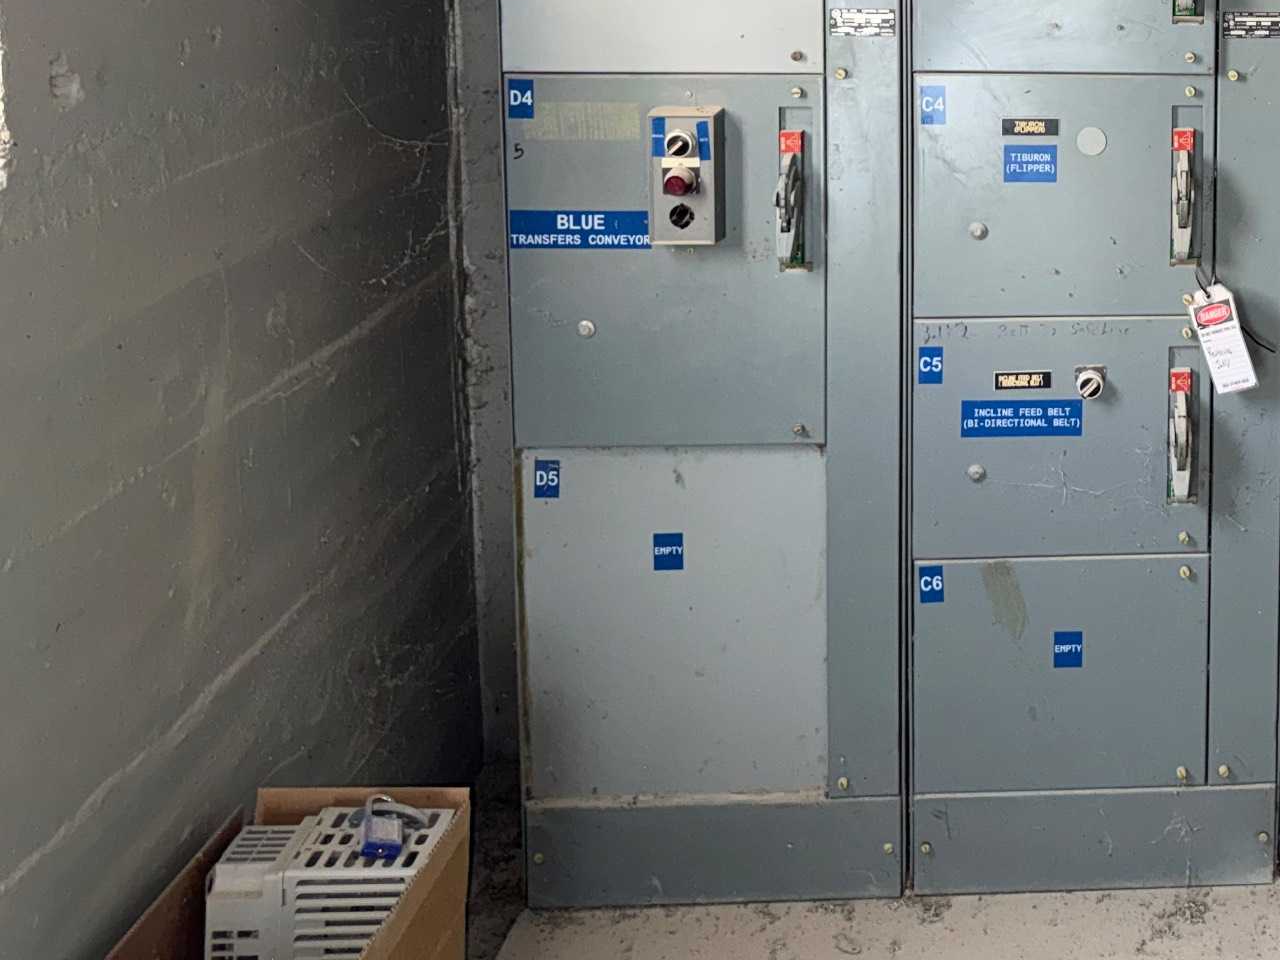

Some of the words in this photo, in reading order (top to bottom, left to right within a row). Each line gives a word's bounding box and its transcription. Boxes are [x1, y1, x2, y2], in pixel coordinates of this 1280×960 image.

[510, 90, 533, 105] D4
[922, 97, 944, 111] C4
[1010, 153, 1051, 161] TIBURON
[1006, 163, 1055, 173] (FLIPPER)
[557, 215, 605, 229] BLUE
[511, 234, 581, 245] TRANSFERS
[589, 234, 650, 245] CONVEYOR
[920, 357, 942, 372] C5
[974, 408, 1014, 417] INCLINE
[1019, 408, 1042, 416] FEED
[1048, 408, 1071, 416] BELT
[963, 419, 1048, 428] (BI-DIRECTIONAL
[1053, 418, 1081, 428] BELT)
[536, 471, 558, 485] D5
[655, 546, 683, 555] EMPTY
[921, 576, 942, 591] C6
[1055, 645, 1082, 653] EMPTY
